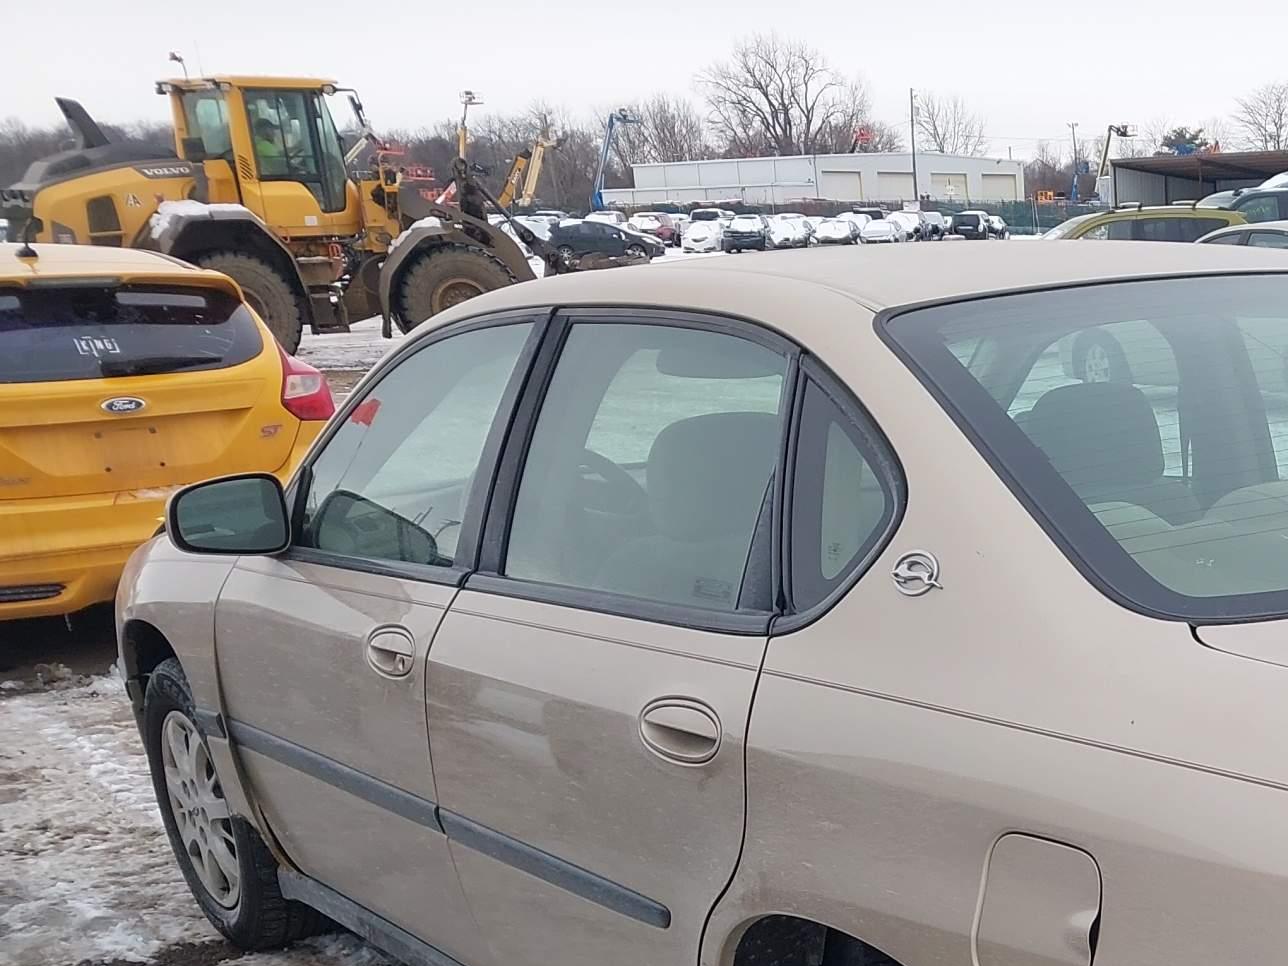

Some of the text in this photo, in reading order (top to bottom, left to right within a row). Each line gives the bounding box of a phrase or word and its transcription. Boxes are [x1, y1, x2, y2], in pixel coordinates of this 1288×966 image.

[142, 166, 190, 176] VOLVO
[111, 399, 137, 412] Ford
[260, 424, 282, 438] ST
